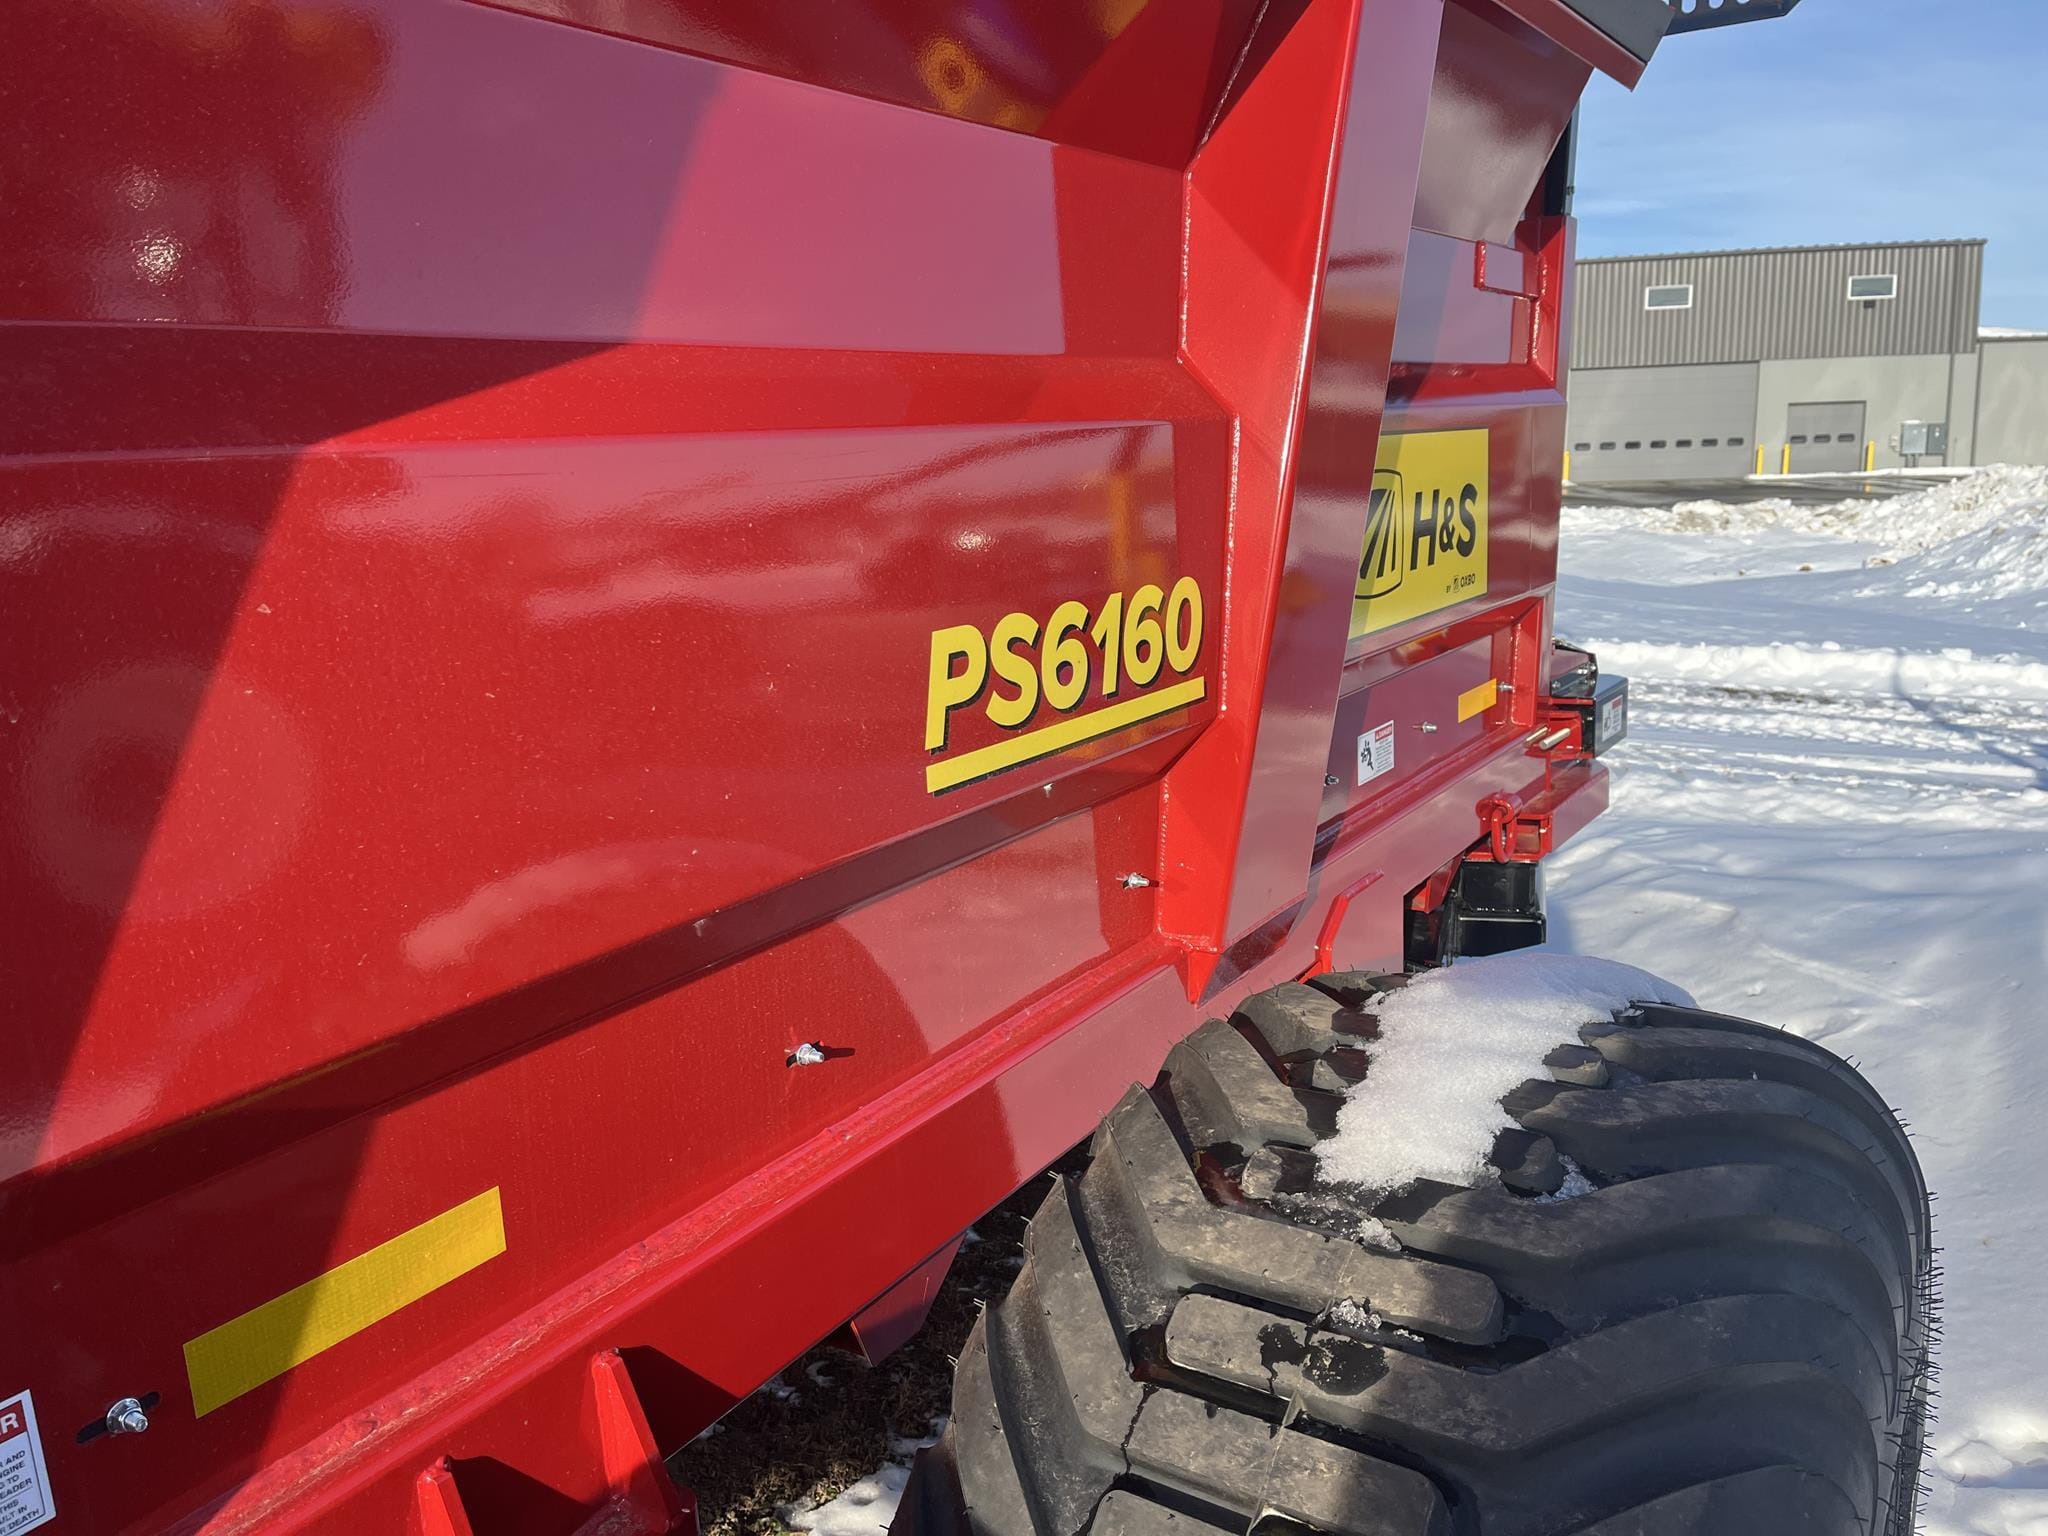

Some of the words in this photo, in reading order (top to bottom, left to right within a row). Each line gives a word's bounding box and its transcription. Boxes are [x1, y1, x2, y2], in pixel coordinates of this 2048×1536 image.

[1410, 482, 1478, 571] H&S
[925, 575, 1205, 755] PS6160
[6, 1450, 26, 1465] AND
[7, 1474, 20, 1484] TO
[8, 1507, 40, 1527] DEATH
